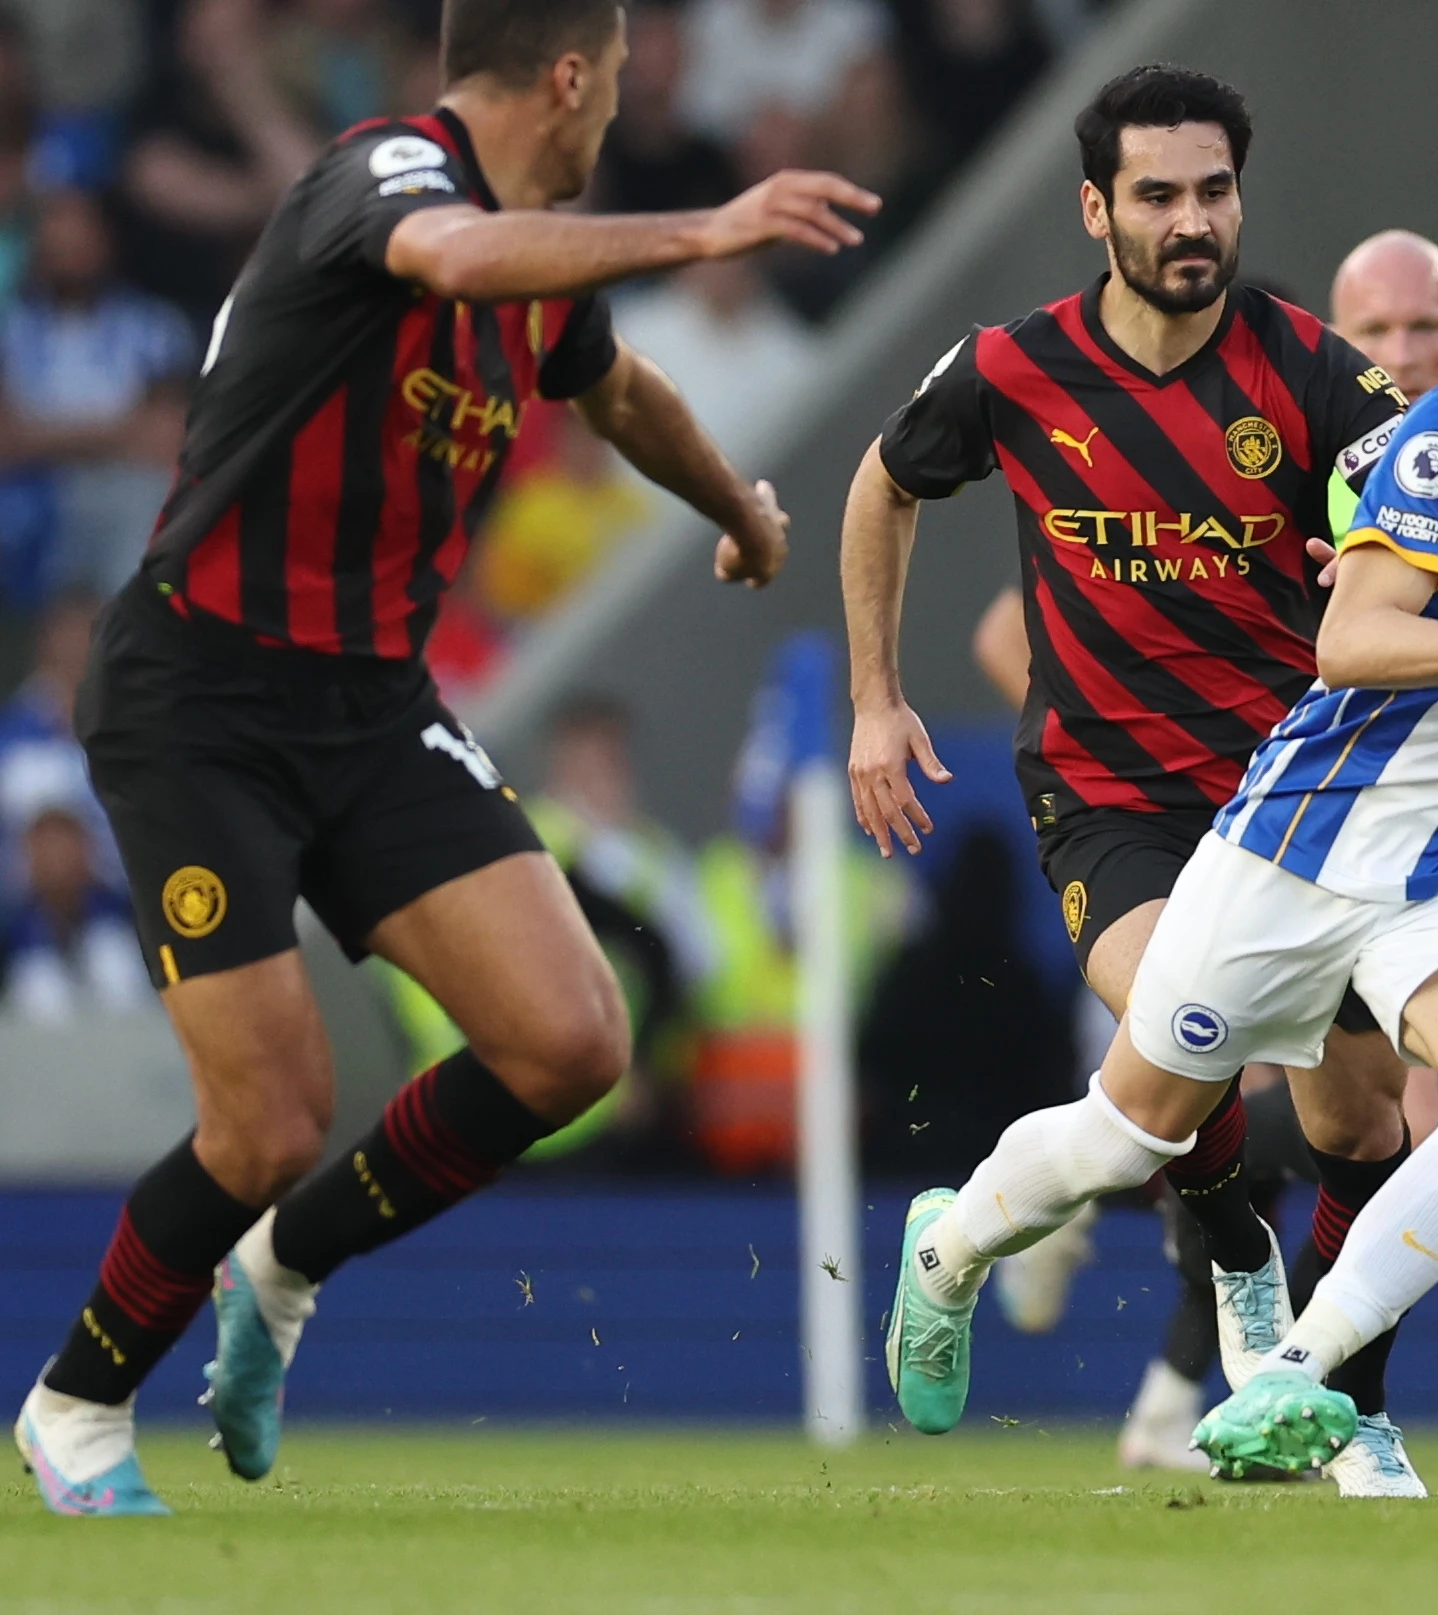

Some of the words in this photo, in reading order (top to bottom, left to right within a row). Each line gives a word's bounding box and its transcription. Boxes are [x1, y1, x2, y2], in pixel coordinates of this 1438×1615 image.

[1356, 366, 1395, 394] NE
[1044, 507, 1286, 549] ETIHAD
[1376, 505, 1401, 524] No
[1090, 552, 1251, 583] AIRWAYS
